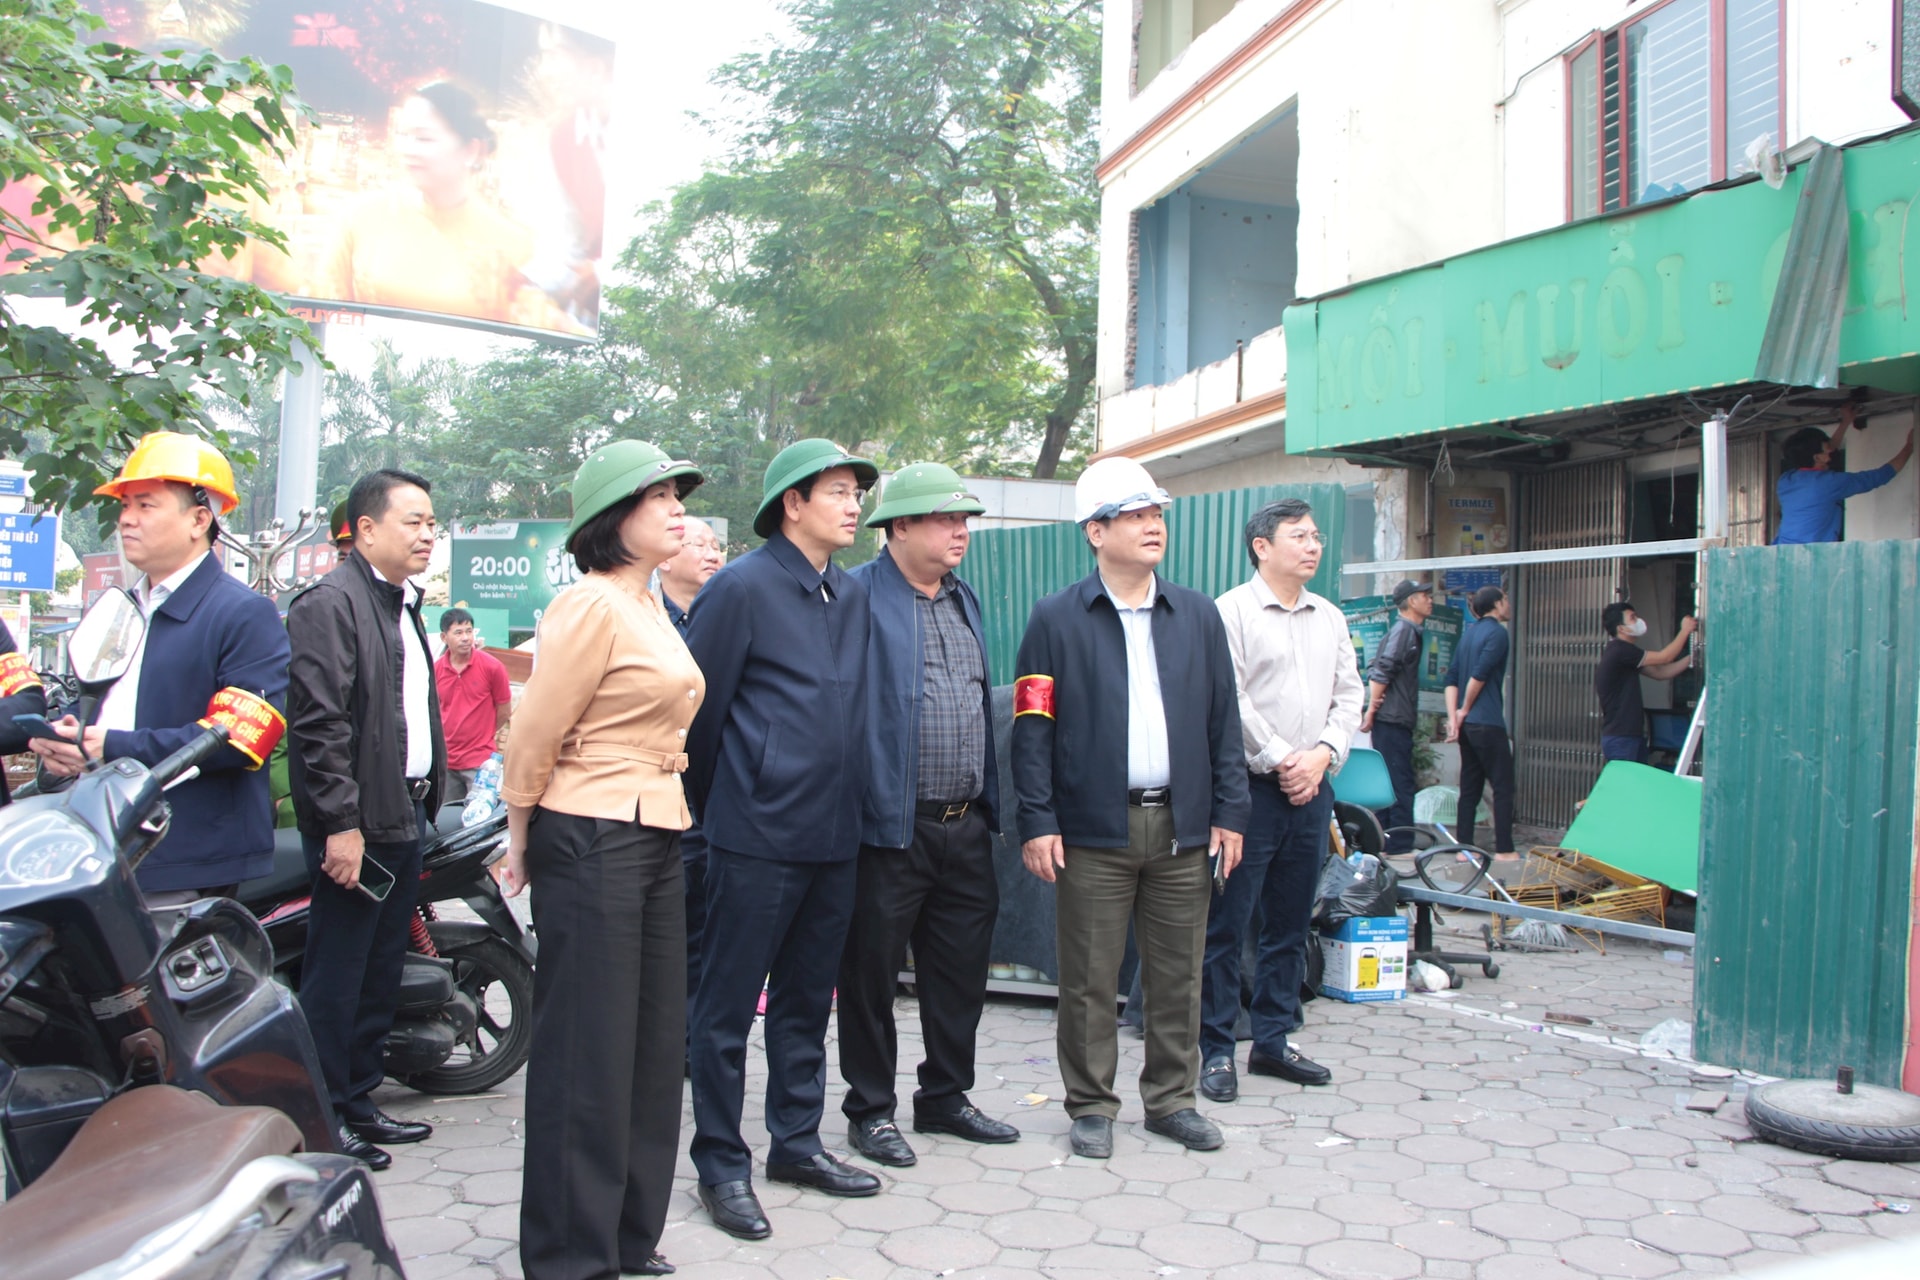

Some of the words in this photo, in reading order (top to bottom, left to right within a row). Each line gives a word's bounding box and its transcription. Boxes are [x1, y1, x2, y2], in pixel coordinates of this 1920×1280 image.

[1447, 498, 1495, 508] TERMIZE
[470, 556, 531, 576] 20:00
[499, 583, 514, 592] hàng
